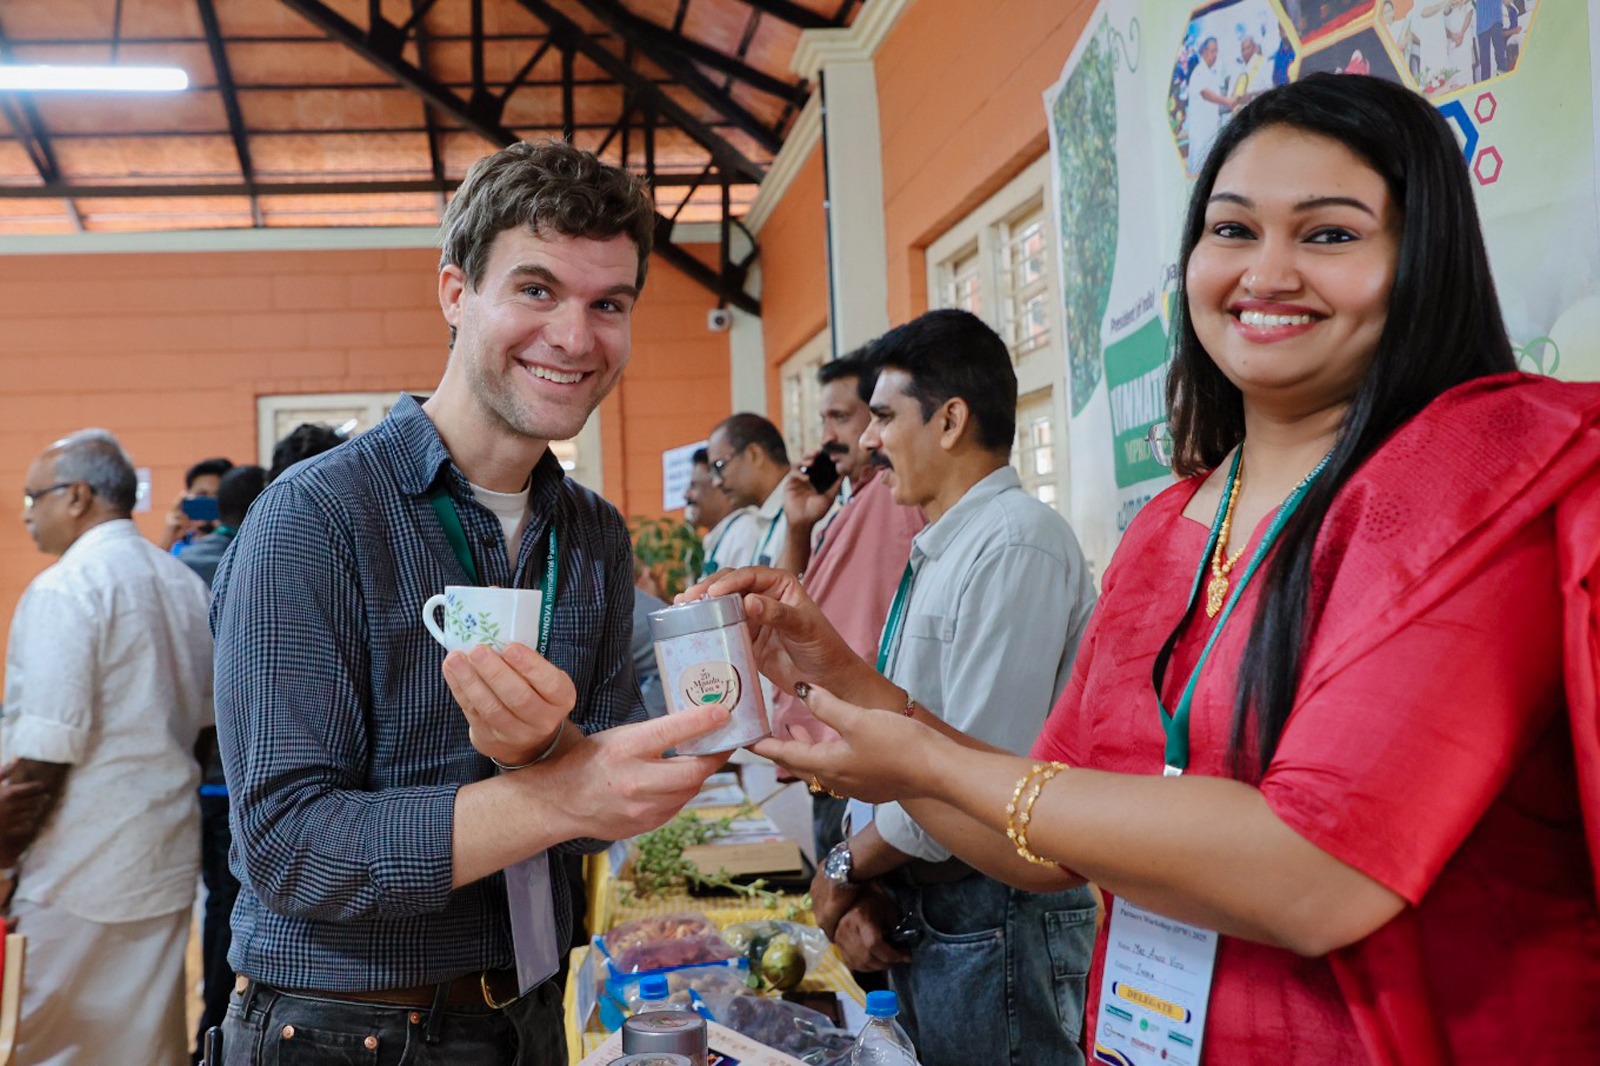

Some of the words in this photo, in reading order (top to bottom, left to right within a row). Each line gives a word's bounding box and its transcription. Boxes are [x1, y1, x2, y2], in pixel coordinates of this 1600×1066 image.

[545, 560, 555, 602] International
[1143, 916, 1172, 933] Workshop
[1127, 989, 1174, 1014] DELEGATE
